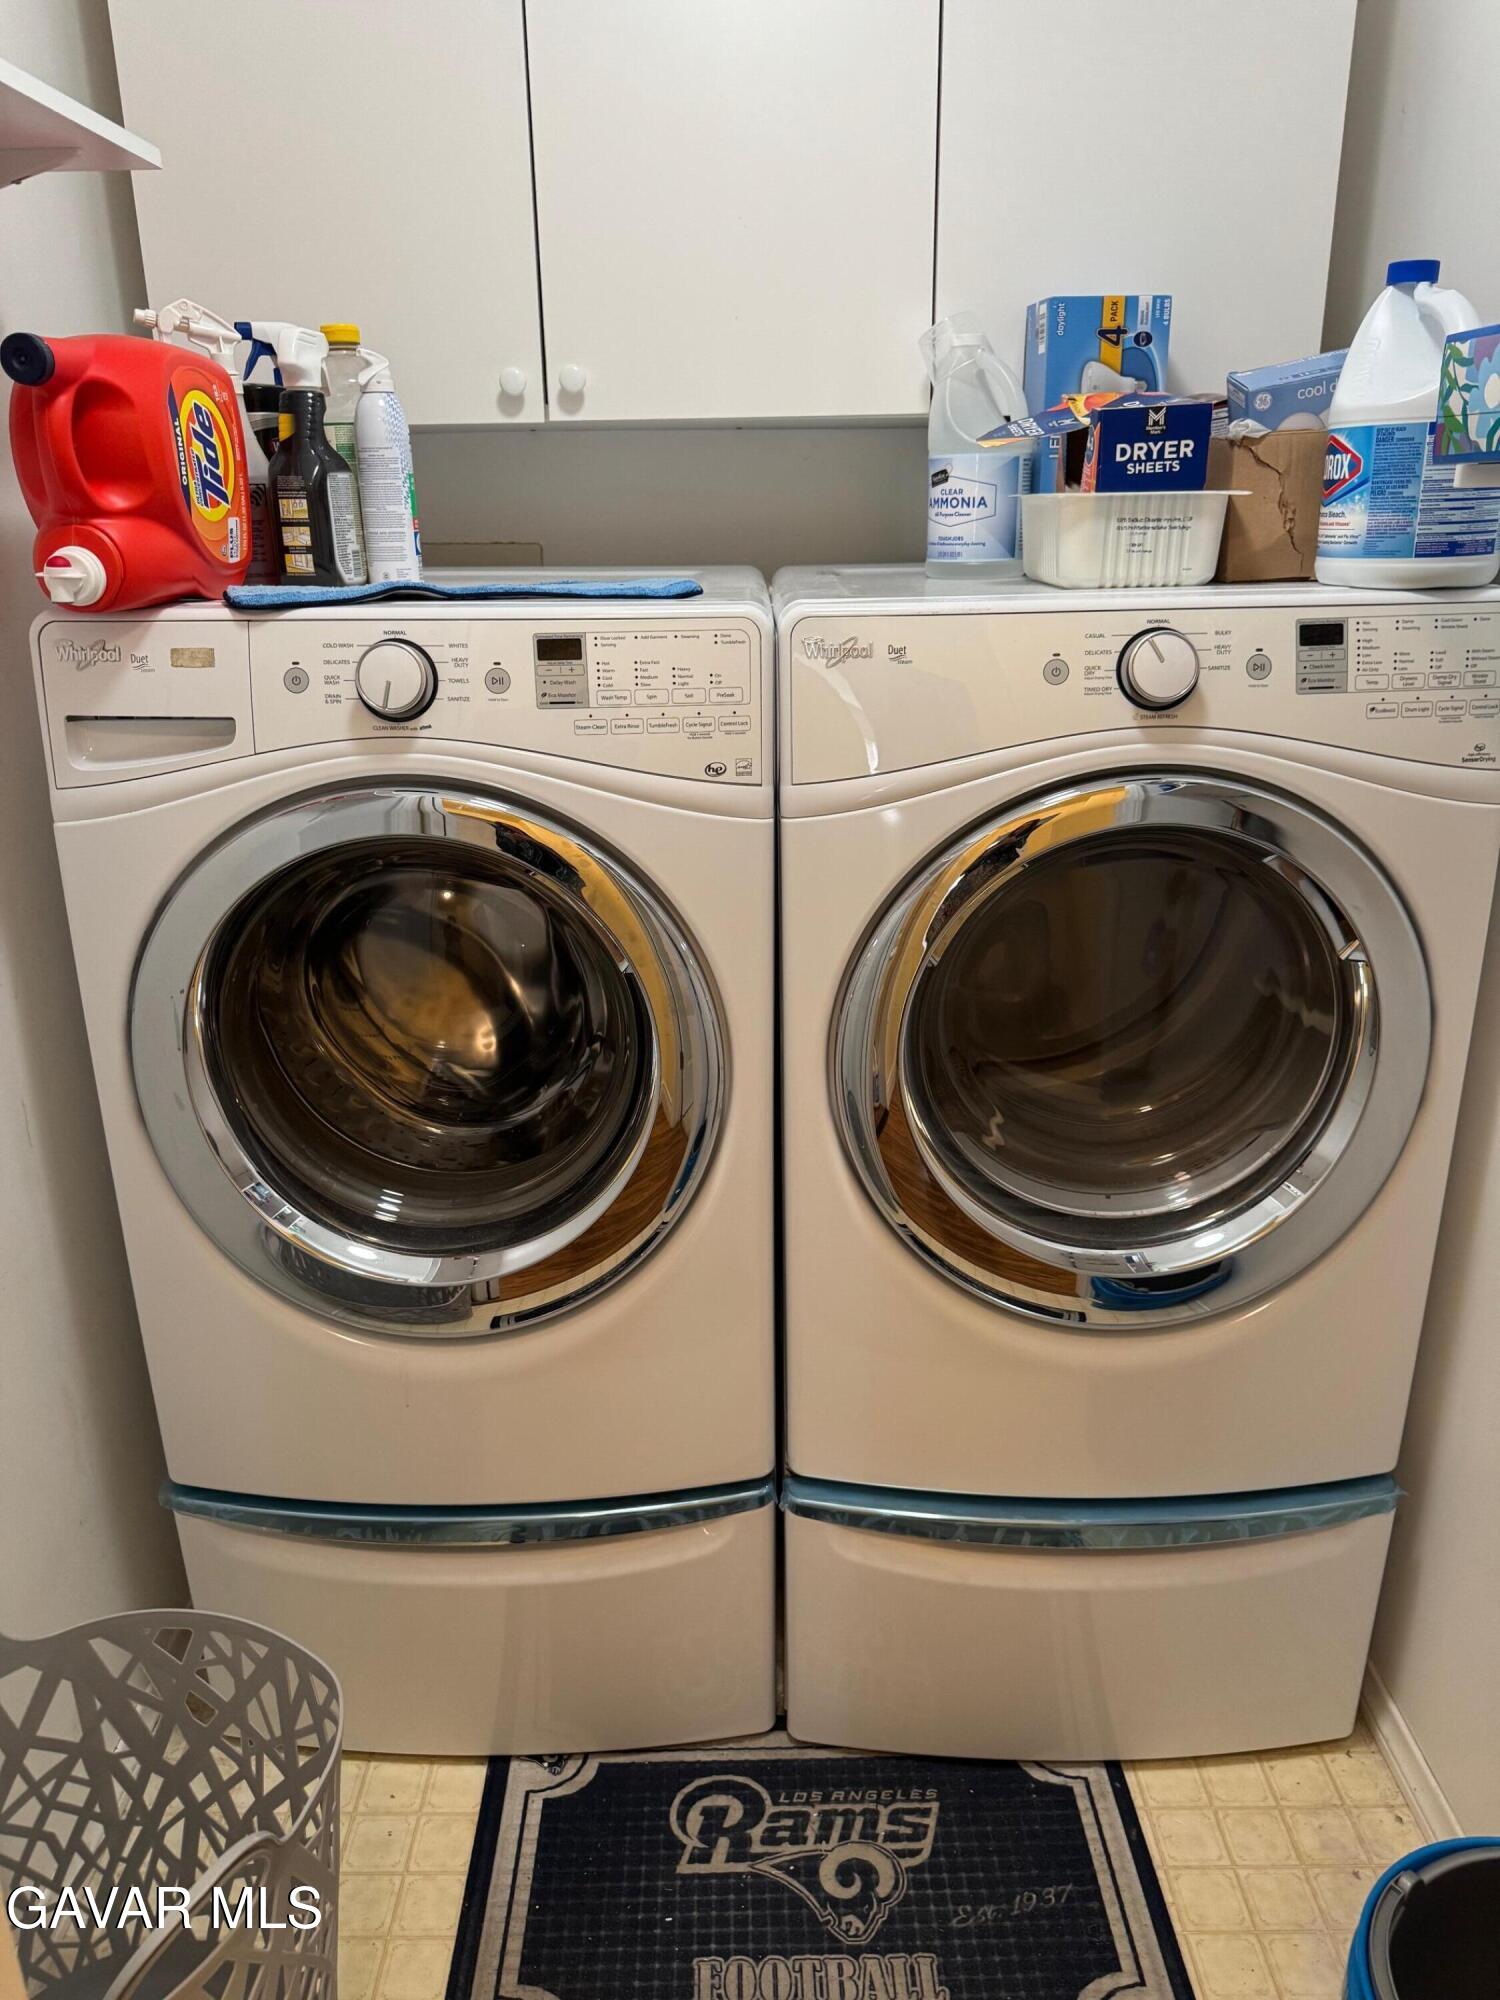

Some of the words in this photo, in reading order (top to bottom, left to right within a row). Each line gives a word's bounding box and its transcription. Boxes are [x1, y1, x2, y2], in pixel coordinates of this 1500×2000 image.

[1056, 303, 1066, 336] daylight
[1110, 300, 1120, 322] PACK
[1096, 325, 1128, 347] 4
[1297, 381, 1326, 400] cool
[174, 418, 188, 486] ORIGINAL
[189, 399, 231, 512] Tide
[1115, 439, 1195, 463] DRYER
[1126, 460, 1180, 476] SHEETS
[941, 488, 964, 496] CLEAR
[54, 640, 122, 666] Whirlpool
[130, 653, 149, 664] Duet
[802, 637, 874, 664] Whirlpool
[888, 644, 907, 655] Duet
[778, 1791, 823, 1803] LOS
[831, 1788, 939, 1802] ANGELES
[670, 1775, 940, 1874] Rams
[694, 1953, 951, 2000] FOOTBALL
